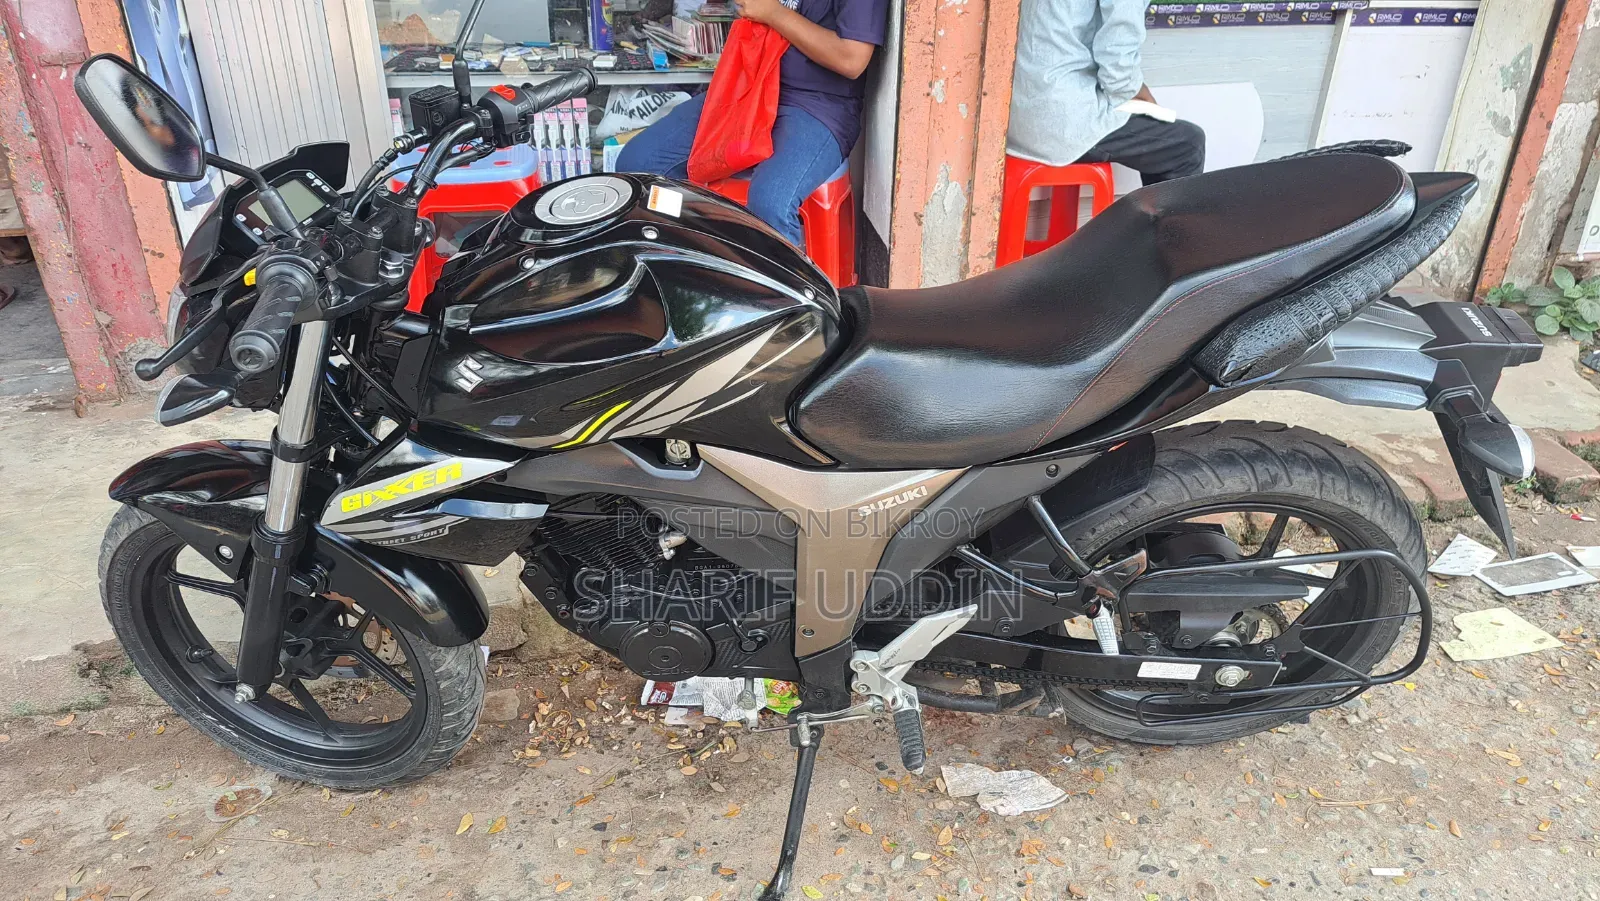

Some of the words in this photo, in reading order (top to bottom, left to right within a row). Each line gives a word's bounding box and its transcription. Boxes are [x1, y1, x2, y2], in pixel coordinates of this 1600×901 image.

[1204, 4, 1229, 12] RIMLO
[1250, 3, 1276, 11] RIMLO
[1295, 2, 1320, 10] RIMLO
[1461, 307, 1493, 337] SUZUKI
[858, 485, 928, 517] SUZUKI
[410, 527, 445, 540] SPORT
